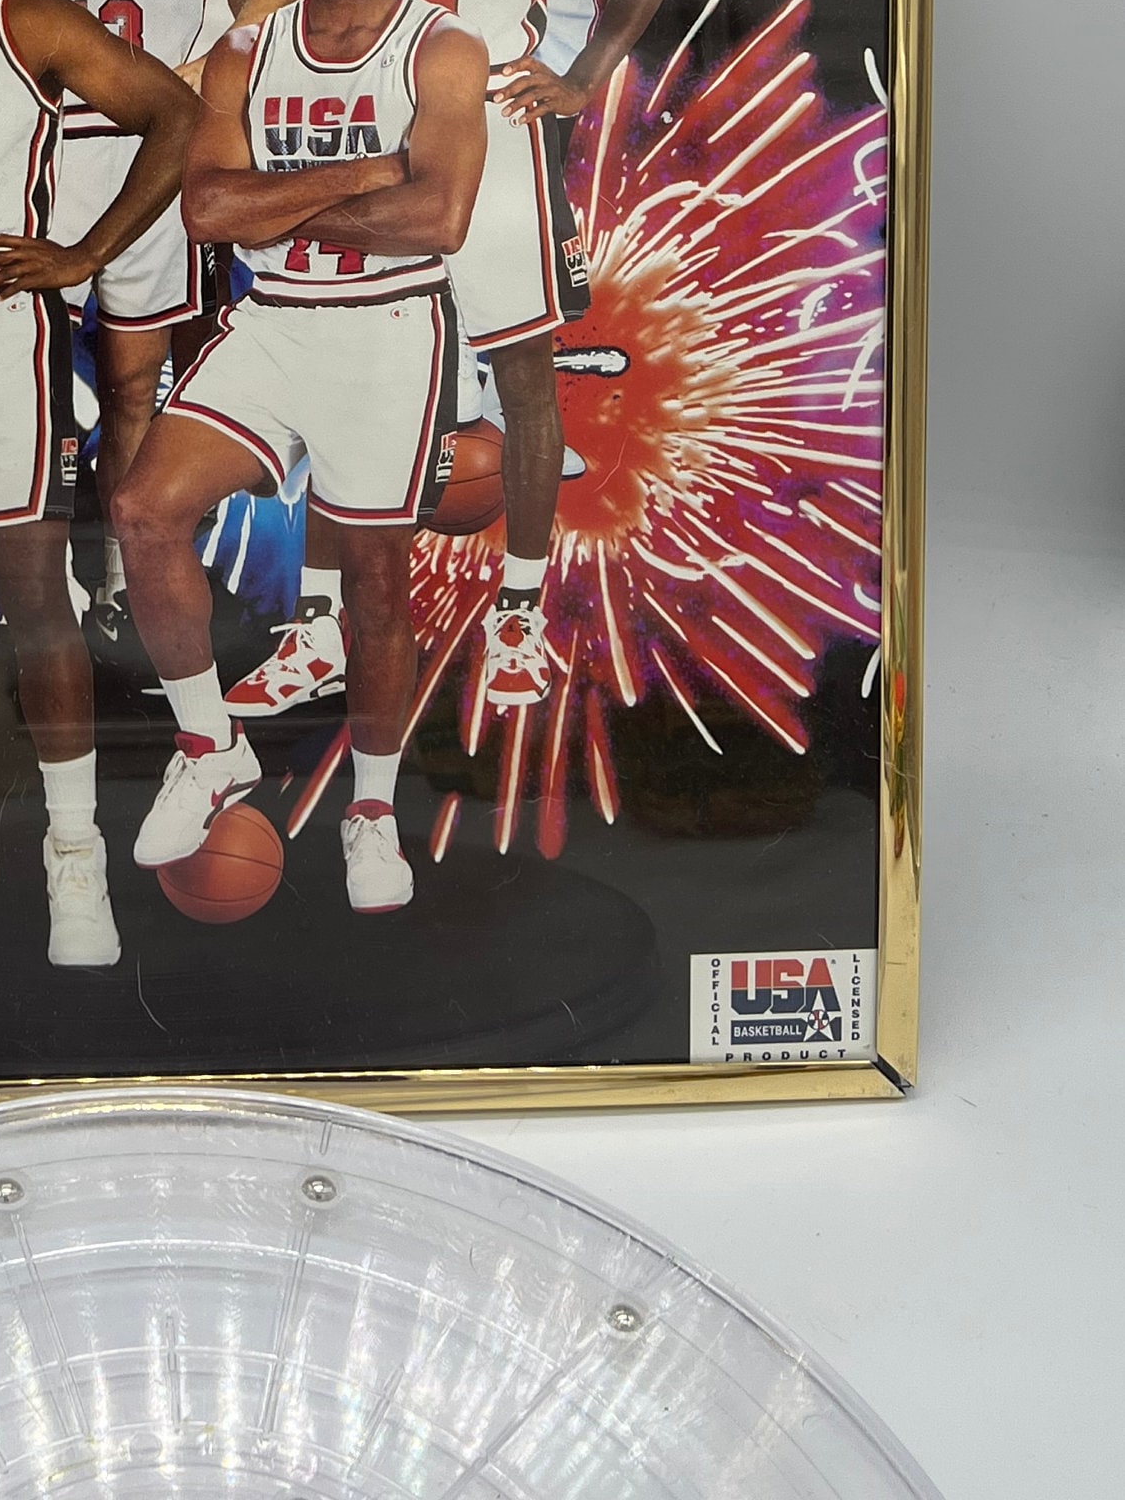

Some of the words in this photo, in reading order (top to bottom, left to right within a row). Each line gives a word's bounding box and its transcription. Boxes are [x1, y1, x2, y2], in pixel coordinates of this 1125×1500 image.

[263, 95, 383, 157] USA
[710, 957, 722, 1046] OFFICIAL
[730, 957, 842, 1015] USA
[850, 953, 862, 1042] LICENSED
[725, 1049, 847, 1063] PRODUCT
[733, 1024, 803, 1038] BASKETBALL
